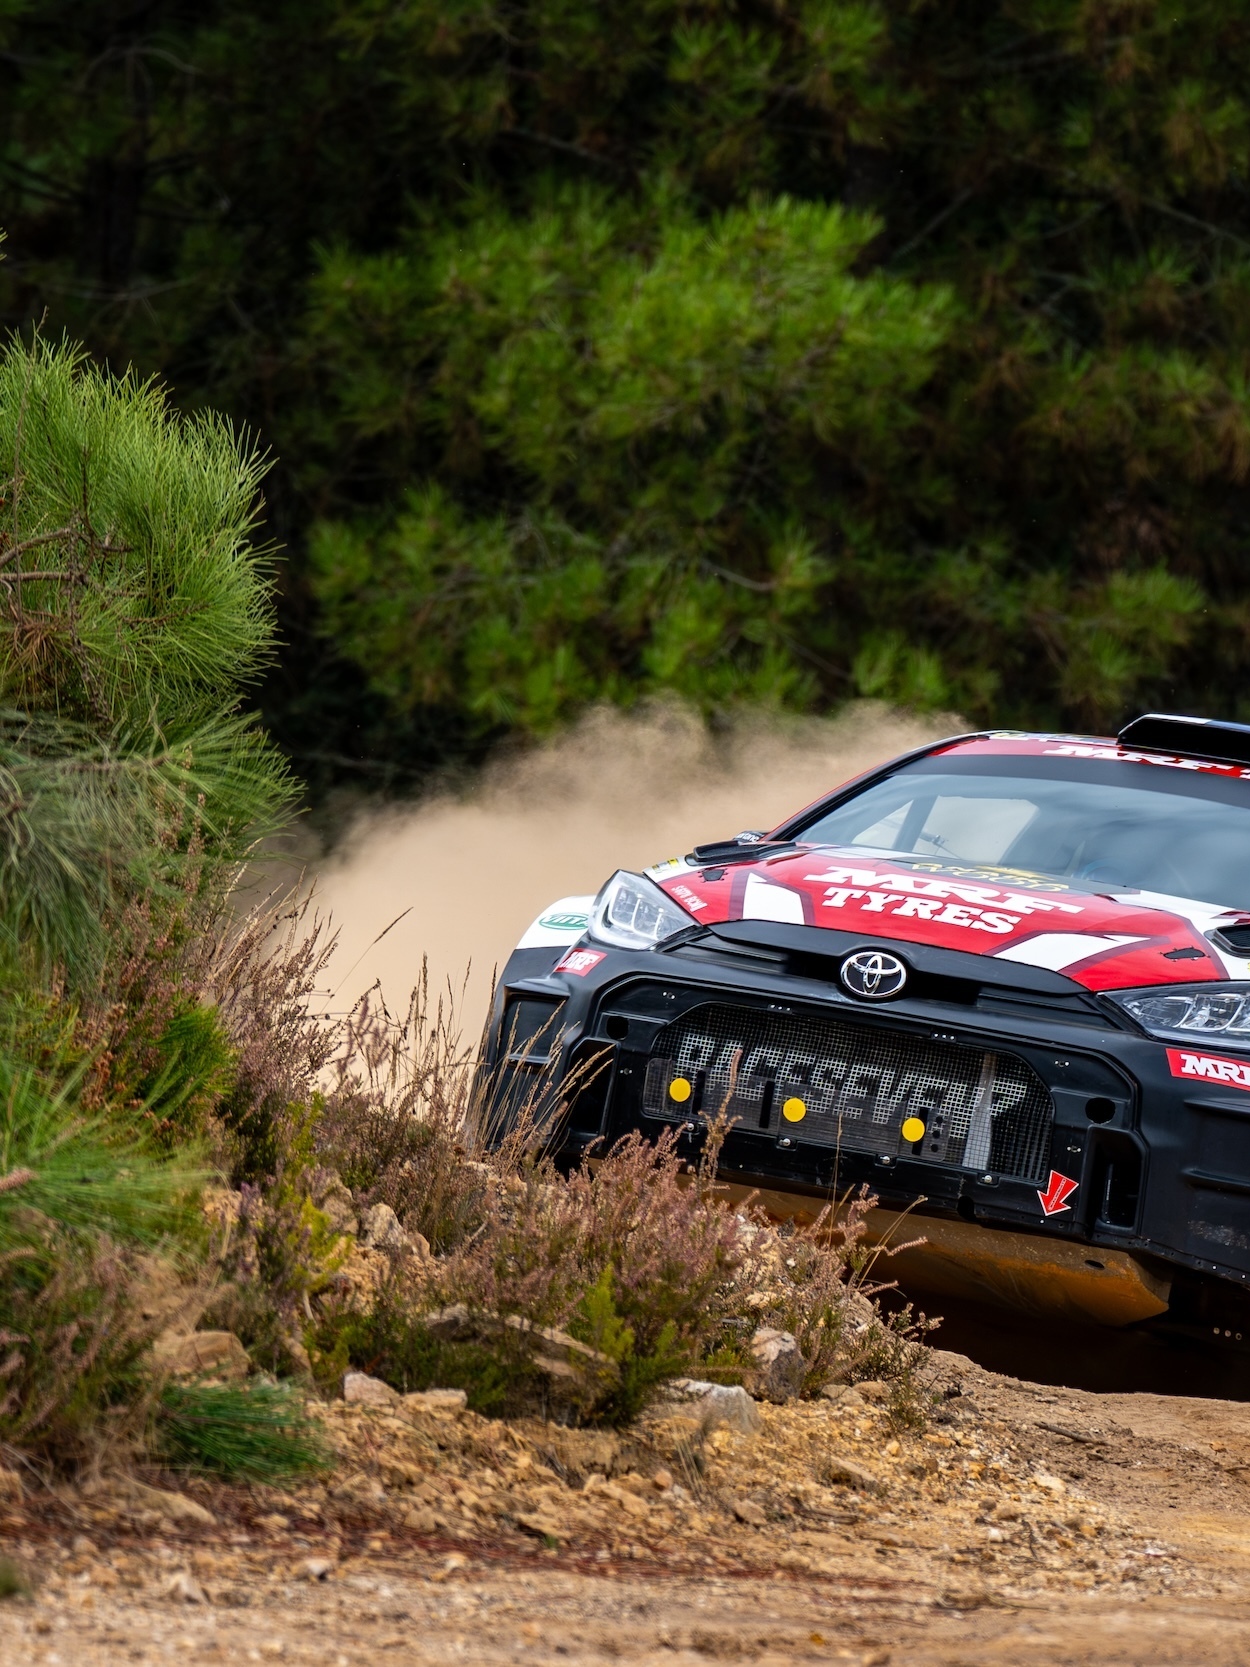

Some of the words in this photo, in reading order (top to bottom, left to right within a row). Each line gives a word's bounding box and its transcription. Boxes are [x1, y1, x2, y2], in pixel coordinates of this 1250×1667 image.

[1043, 745, 1235, 770] MRF
[804, 866, 1086, 914] MRF
[822, 887, 1022, 934] TYRES
